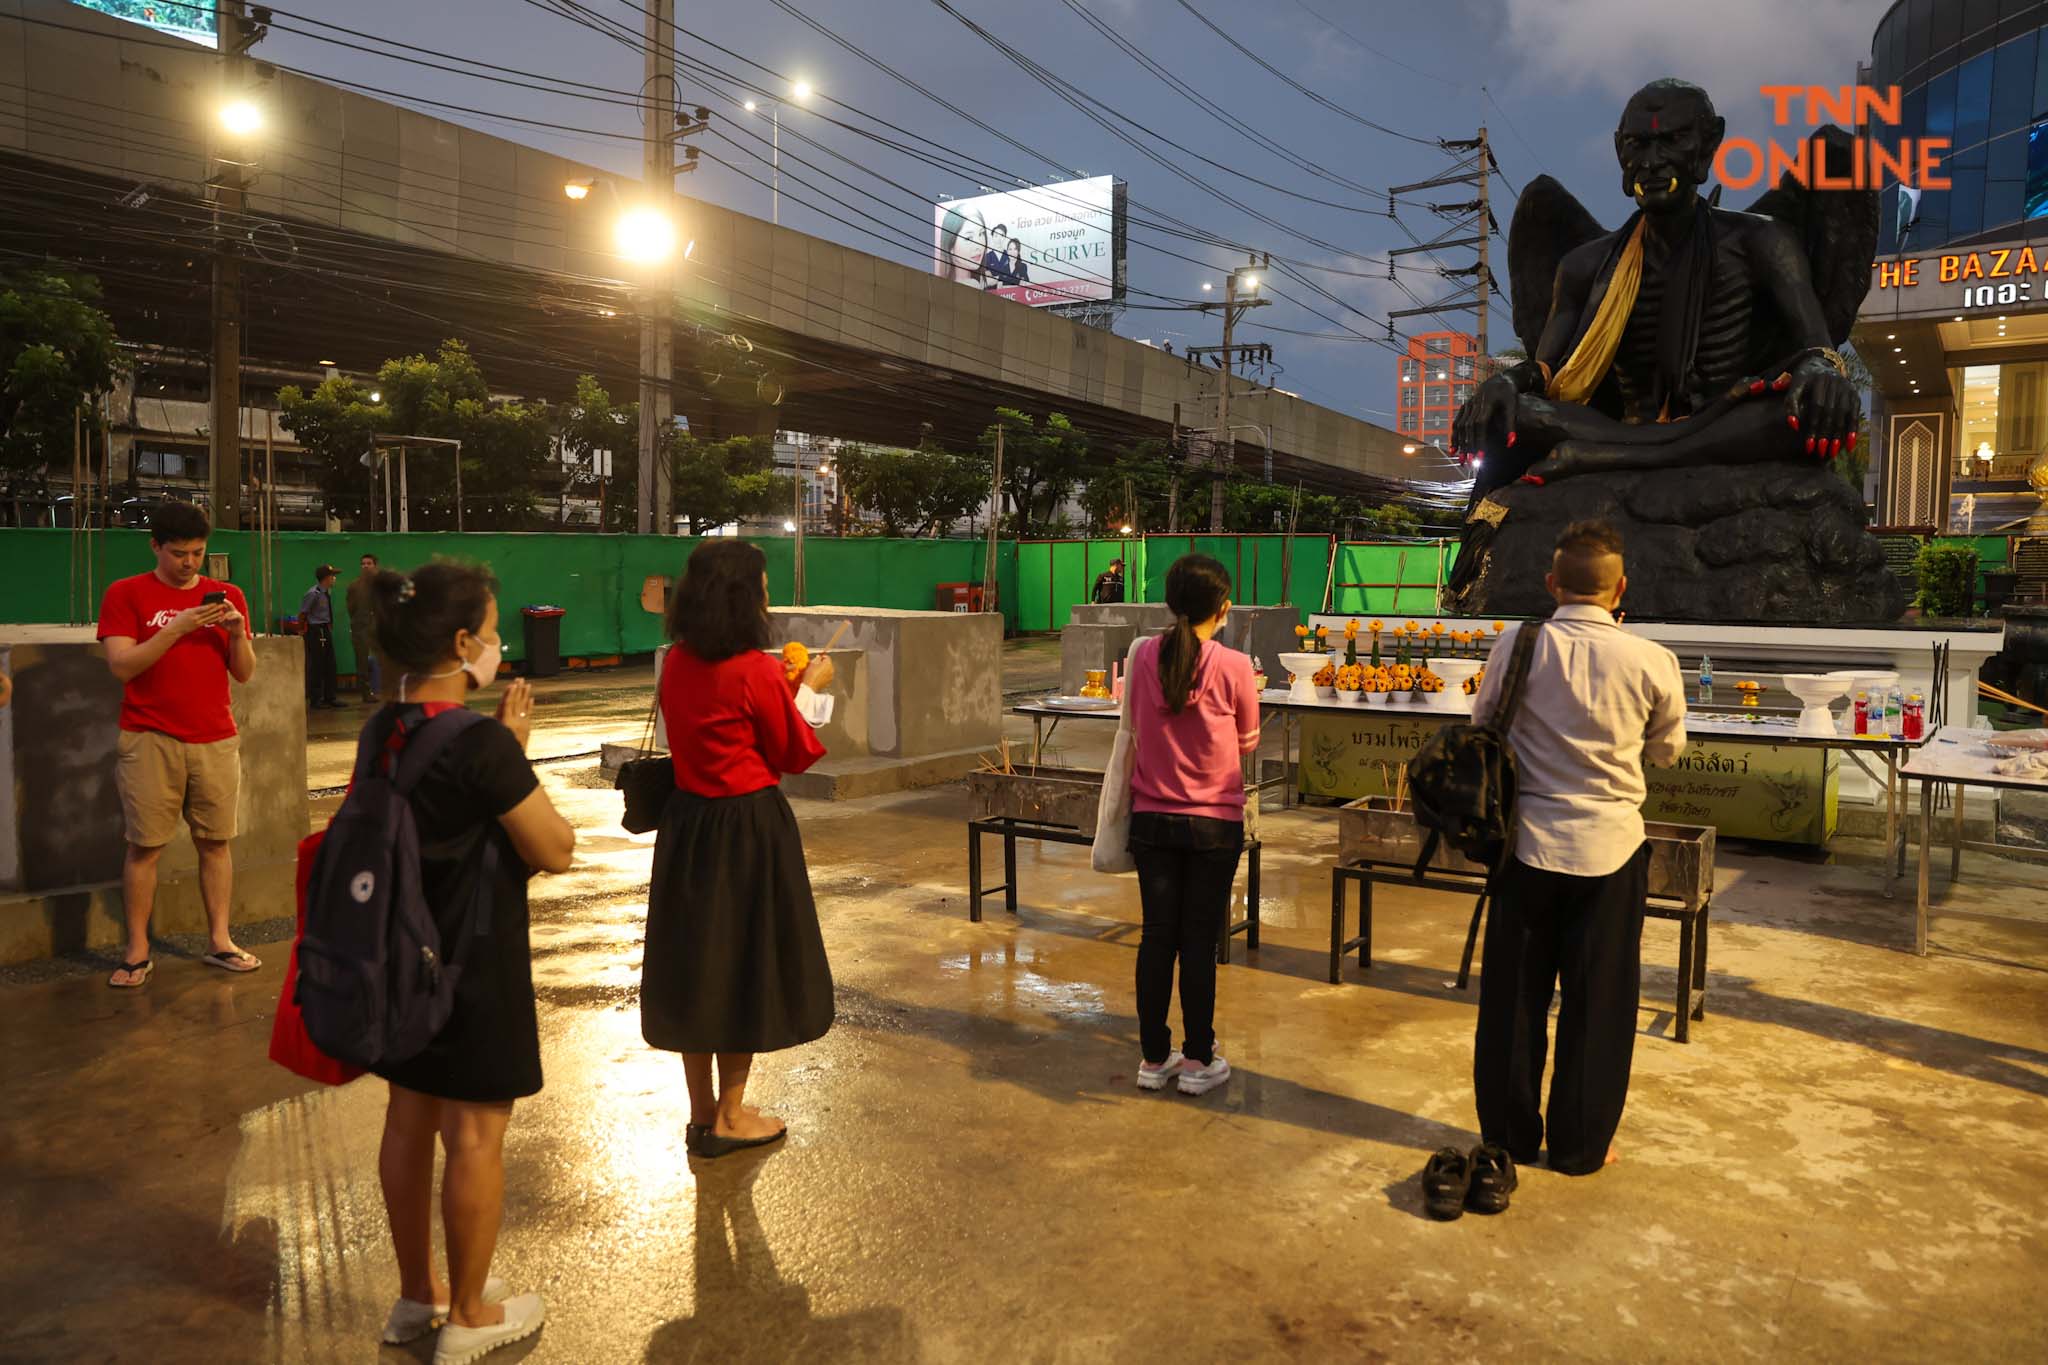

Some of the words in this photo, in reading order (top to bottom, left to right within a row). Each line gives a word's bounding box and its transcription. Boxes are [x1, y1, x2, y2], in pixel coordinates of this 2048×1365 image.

[1030, 252, 1038, 265] S
[1043, 241, 1106, 264] CURVE
[1871, 258, 1920, 288] HE
[1963, 283, 2032, 308] เดอะ
